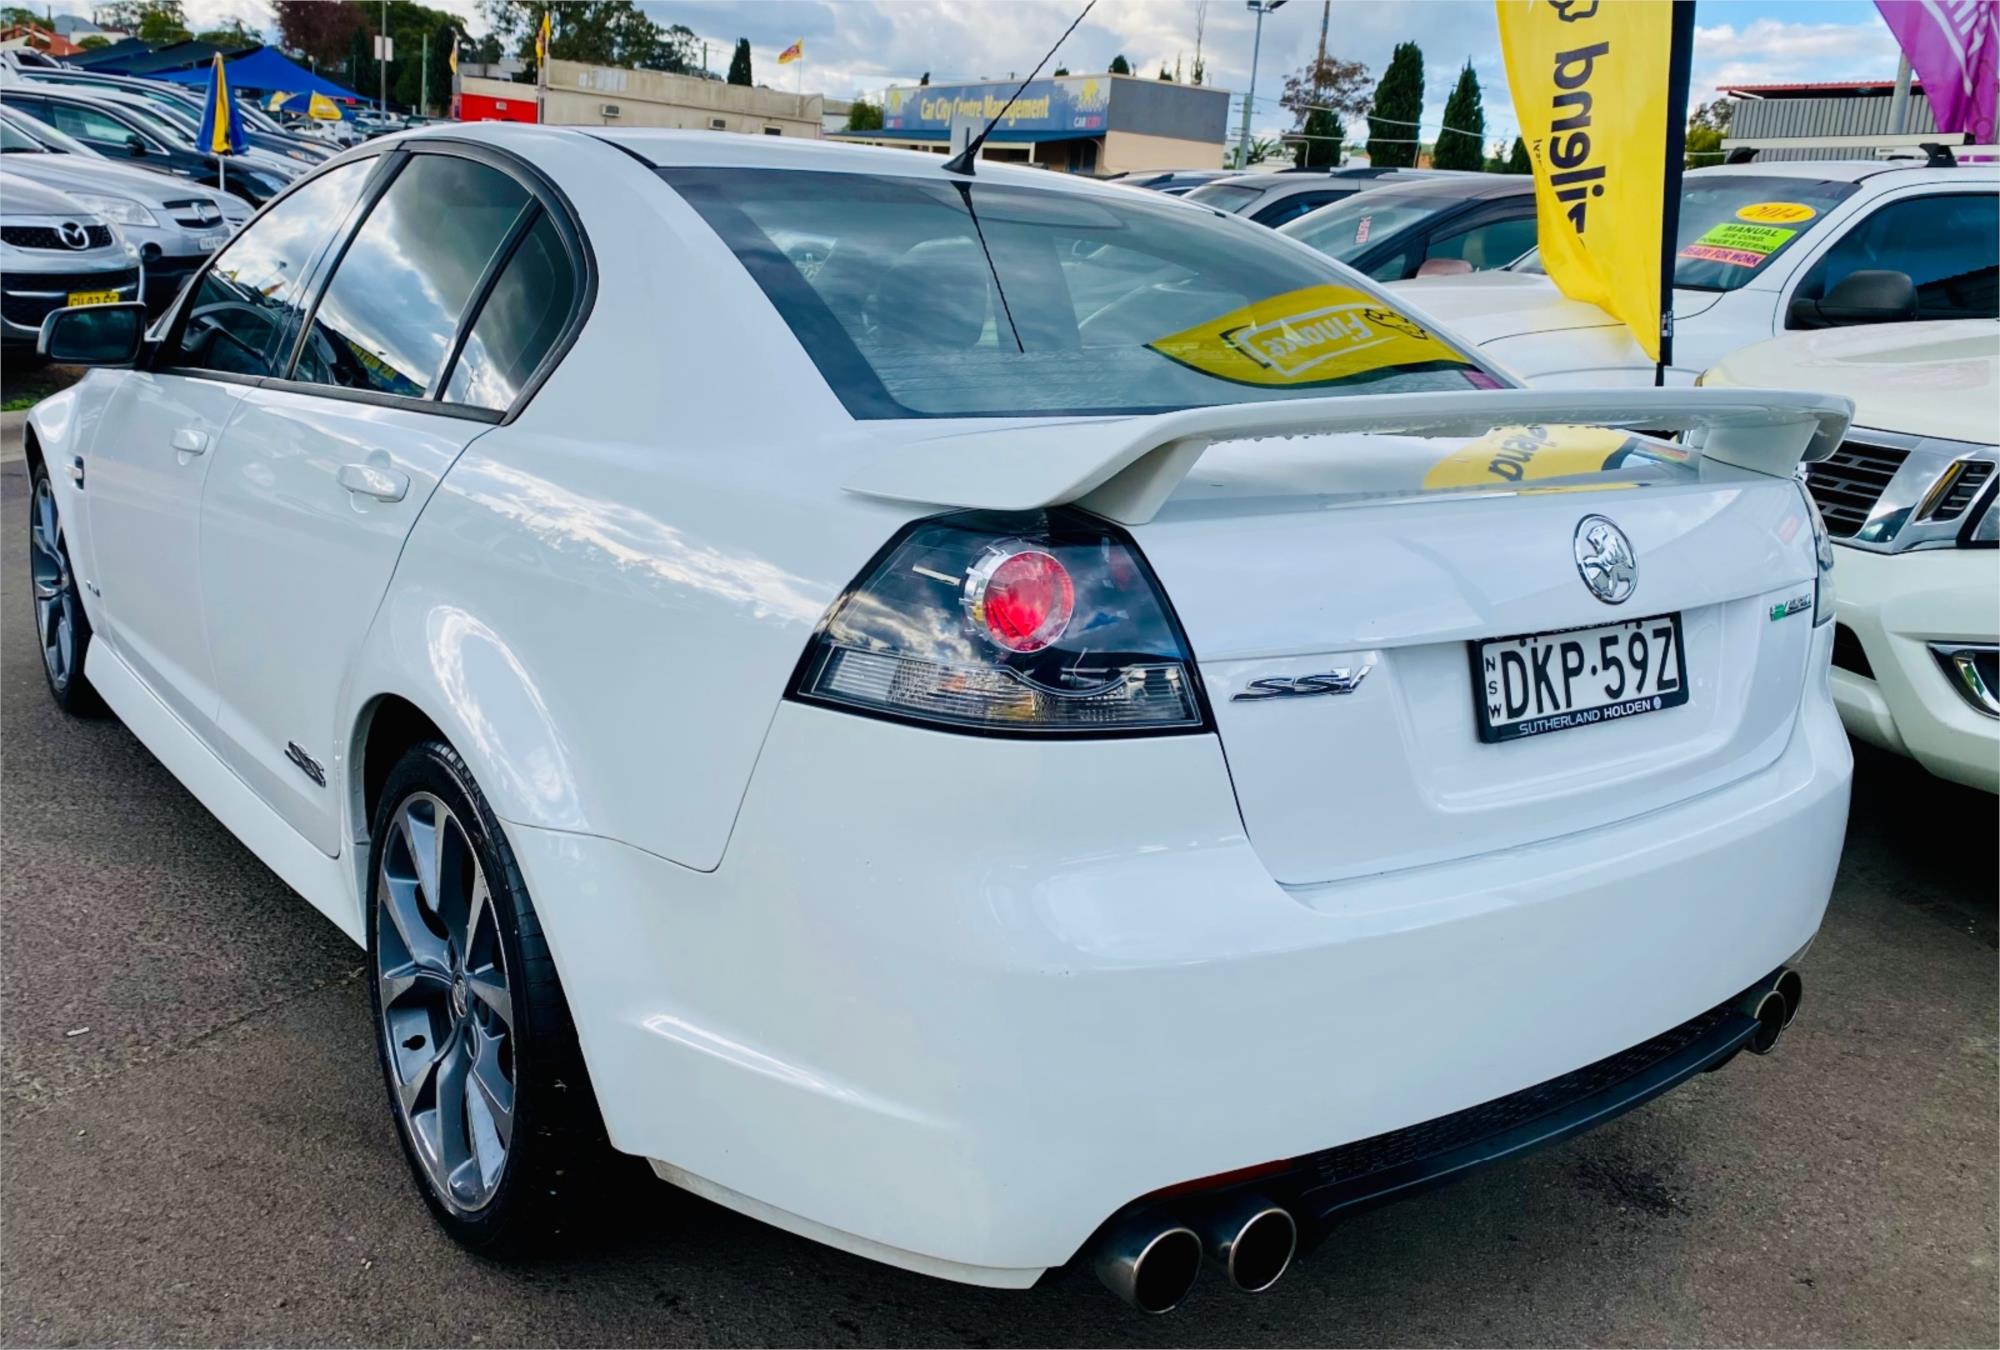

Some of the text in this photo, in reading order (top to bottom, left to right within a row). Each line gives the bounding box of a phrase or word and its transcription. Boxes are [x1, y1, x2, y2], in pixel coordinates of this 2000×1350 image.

[921, 98, 935, 119] Car
[936, 97, 951, 127] City
[984, 94, 1050, 127] Management
[1724, 225, 1779, 237] MANUAL
[1729, 239, 1776, 252] STEERING
[1711, 249, 1730, 259] FOR
[1730, 252, 1761, 265] WORK
[1519, 699, 1651, 736] SUTHERLAND HOLDEN
